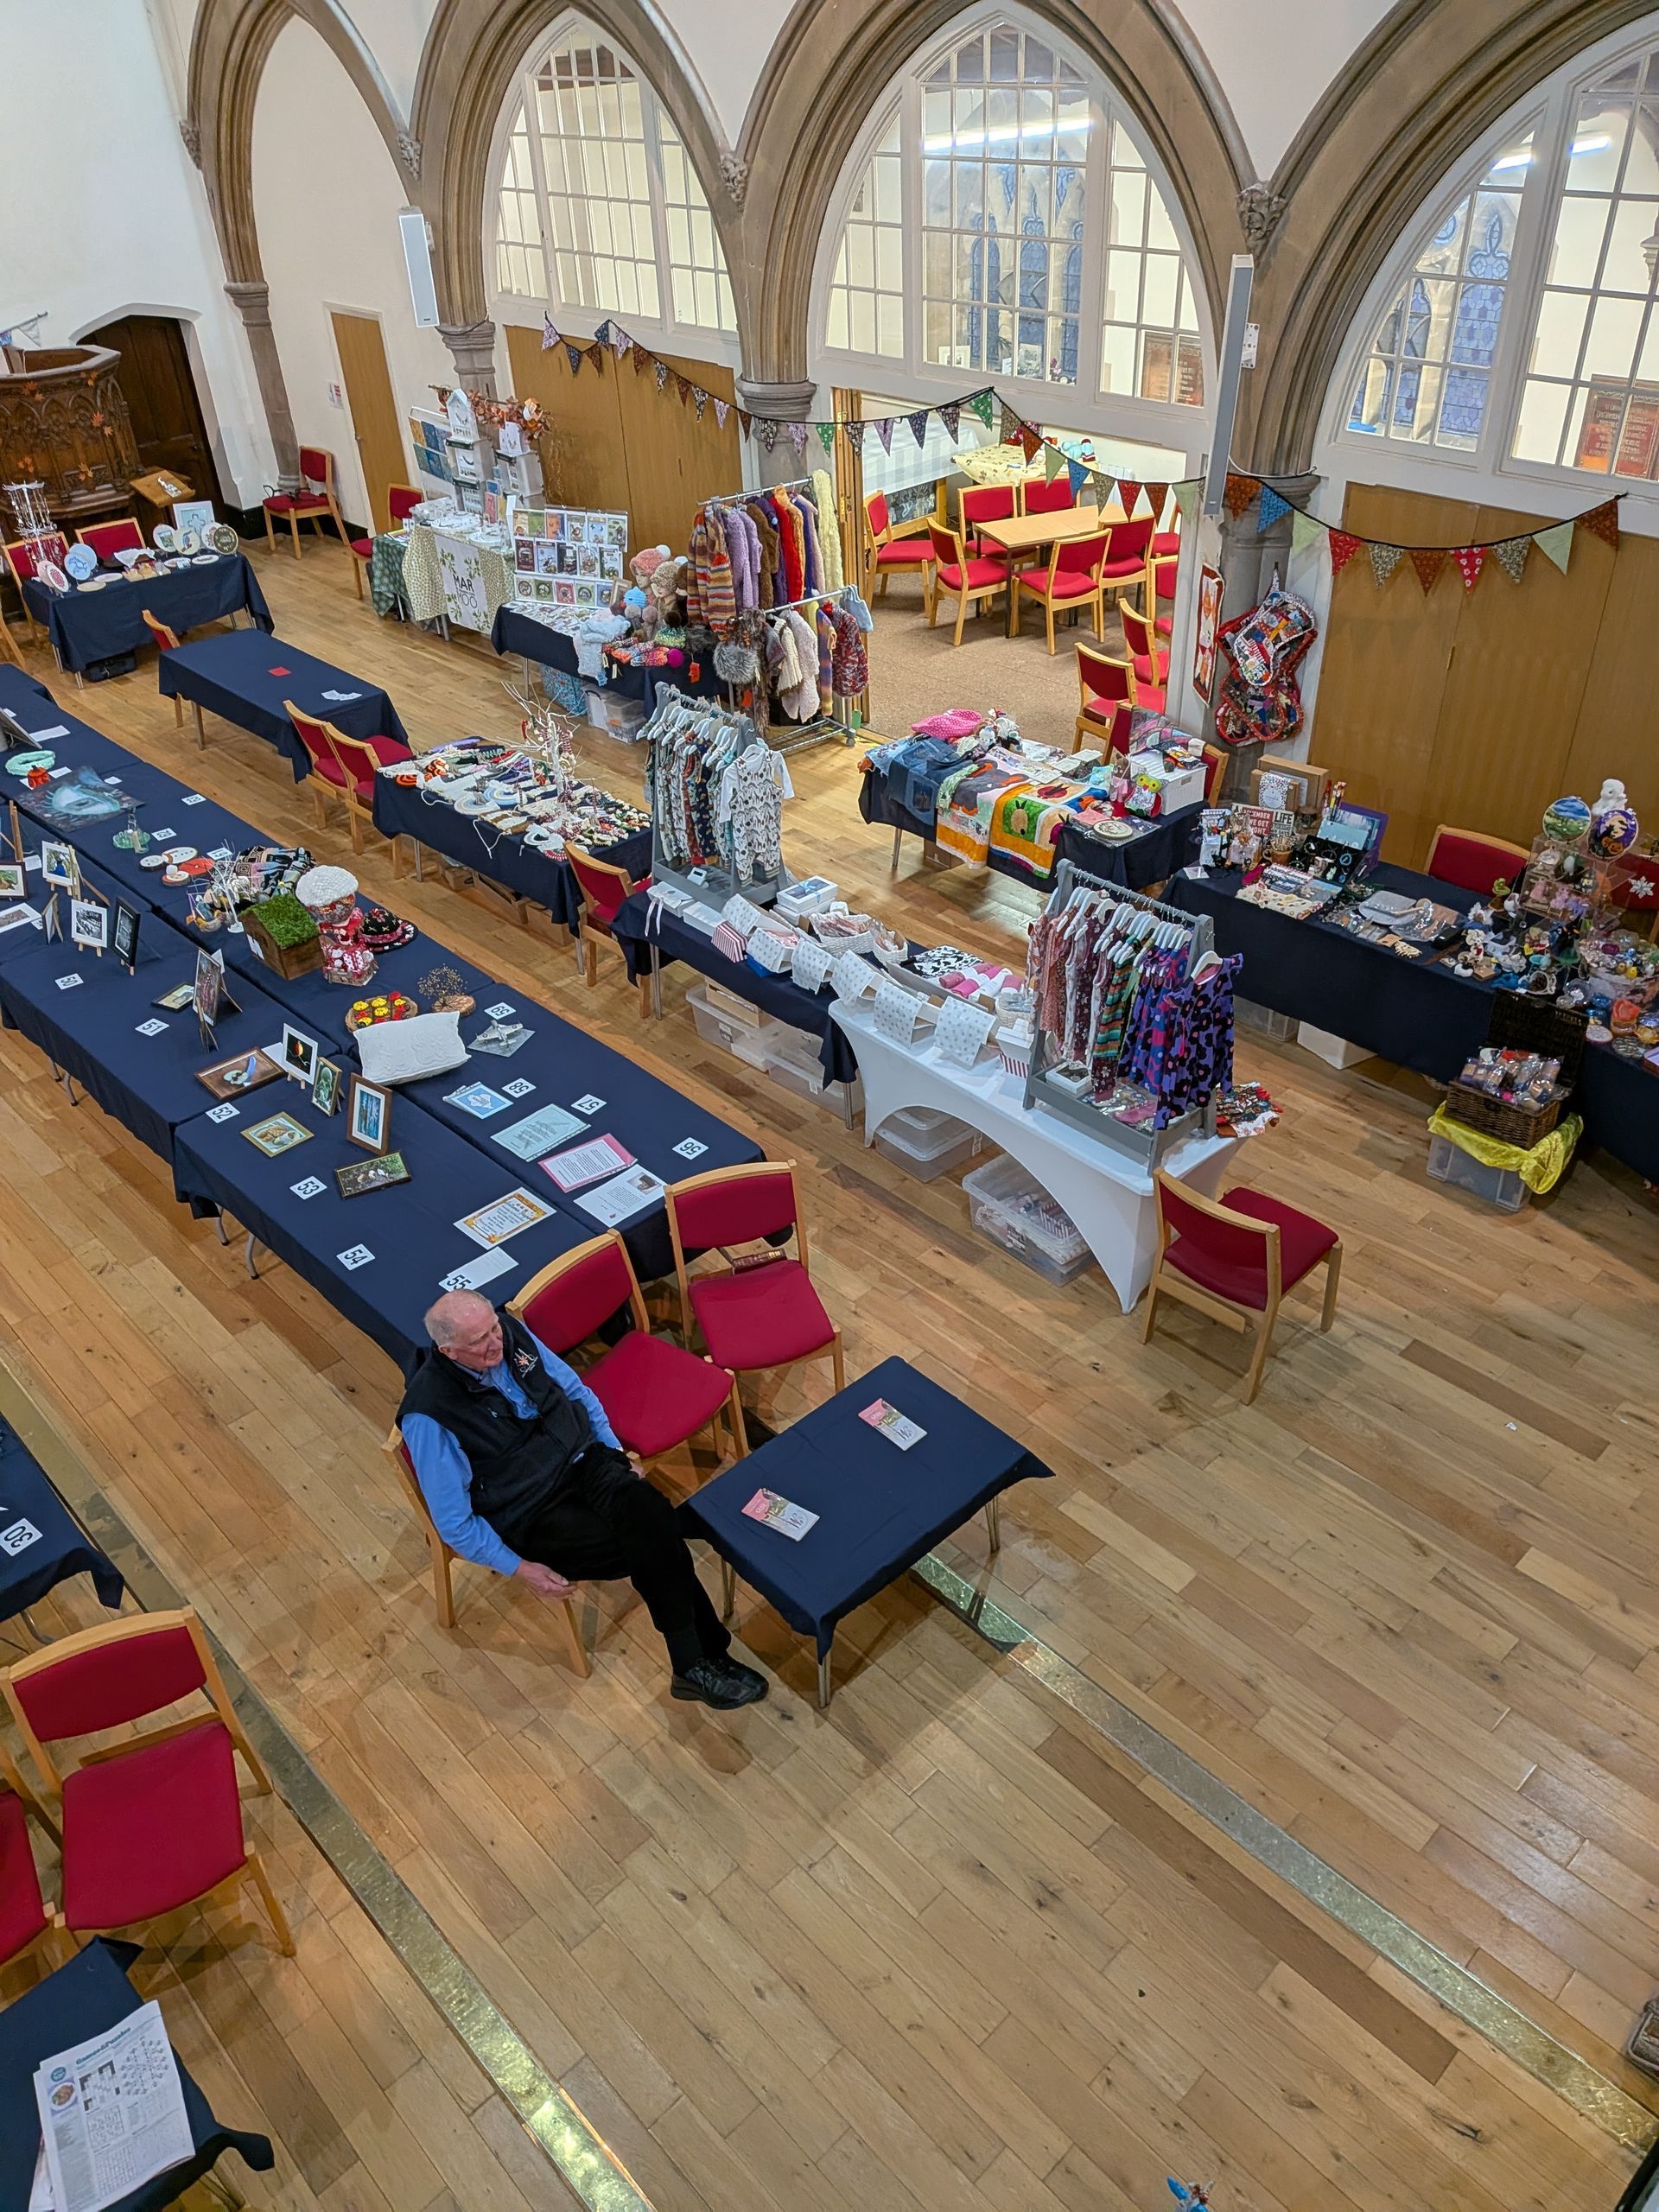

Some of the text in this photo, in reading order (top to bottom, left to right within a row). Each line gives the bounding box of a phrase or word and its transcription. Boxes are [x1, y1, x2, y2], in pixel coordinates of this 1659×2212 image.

[453, 574, 474, 592] MAR
[1274, 811, 1293, 823] LIFE
[60, 976, 78, 987] 50
[491, 1005, 510, 1017] 59
[142, 1021, 161, 1033] 51
[508, 1082, 530, 1095] 58
[577, 1098, 600, 1111] 57
[212, 1106, 233, 1121] 52
[679, 1141, 702, 1156] 56
[296, 1180, 315, 1195] 53
[344, 1249, 361, 1266] 54
[447, 1274, 472, 1290] 55
[3, 1525, 32, 1548] 30
